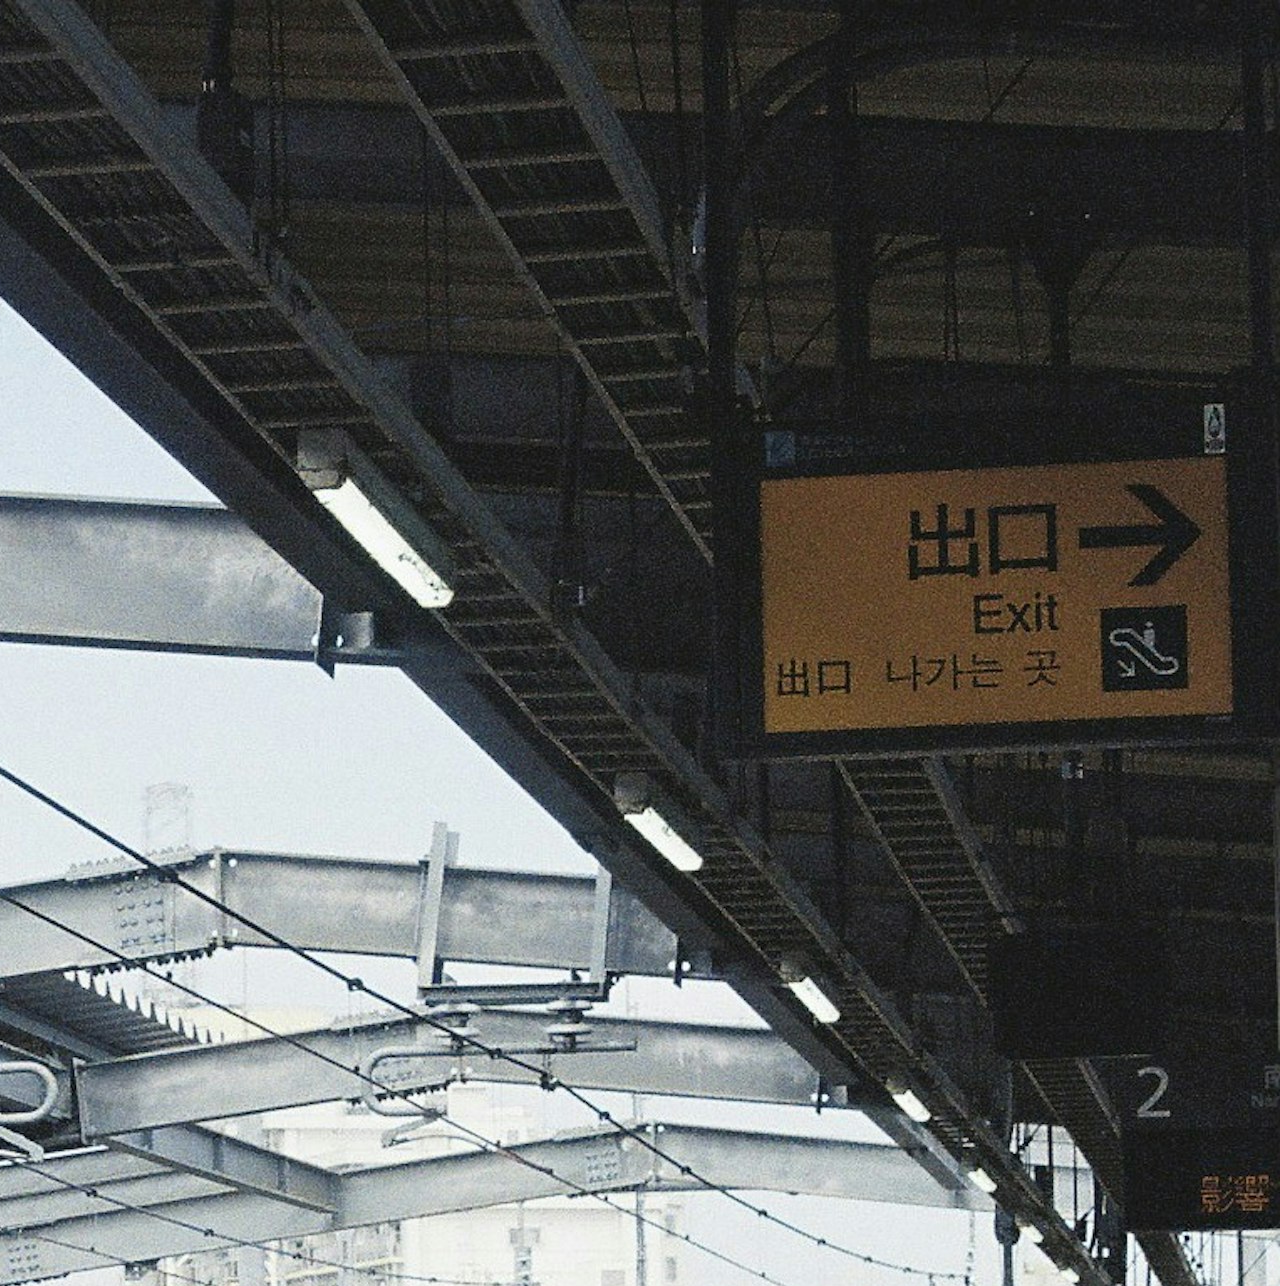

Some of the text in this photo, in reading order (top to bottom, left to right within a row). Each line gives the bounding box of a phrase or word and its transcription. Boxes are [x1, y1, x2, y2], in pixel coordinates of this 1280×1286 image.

[908, 503, 1059, 580] 出口
[973, 591, 1059, 634] Exit
[776, 650, 1060, 698] 出口 나가는 곳
[1137, 1066, 1171, 1118] 2
